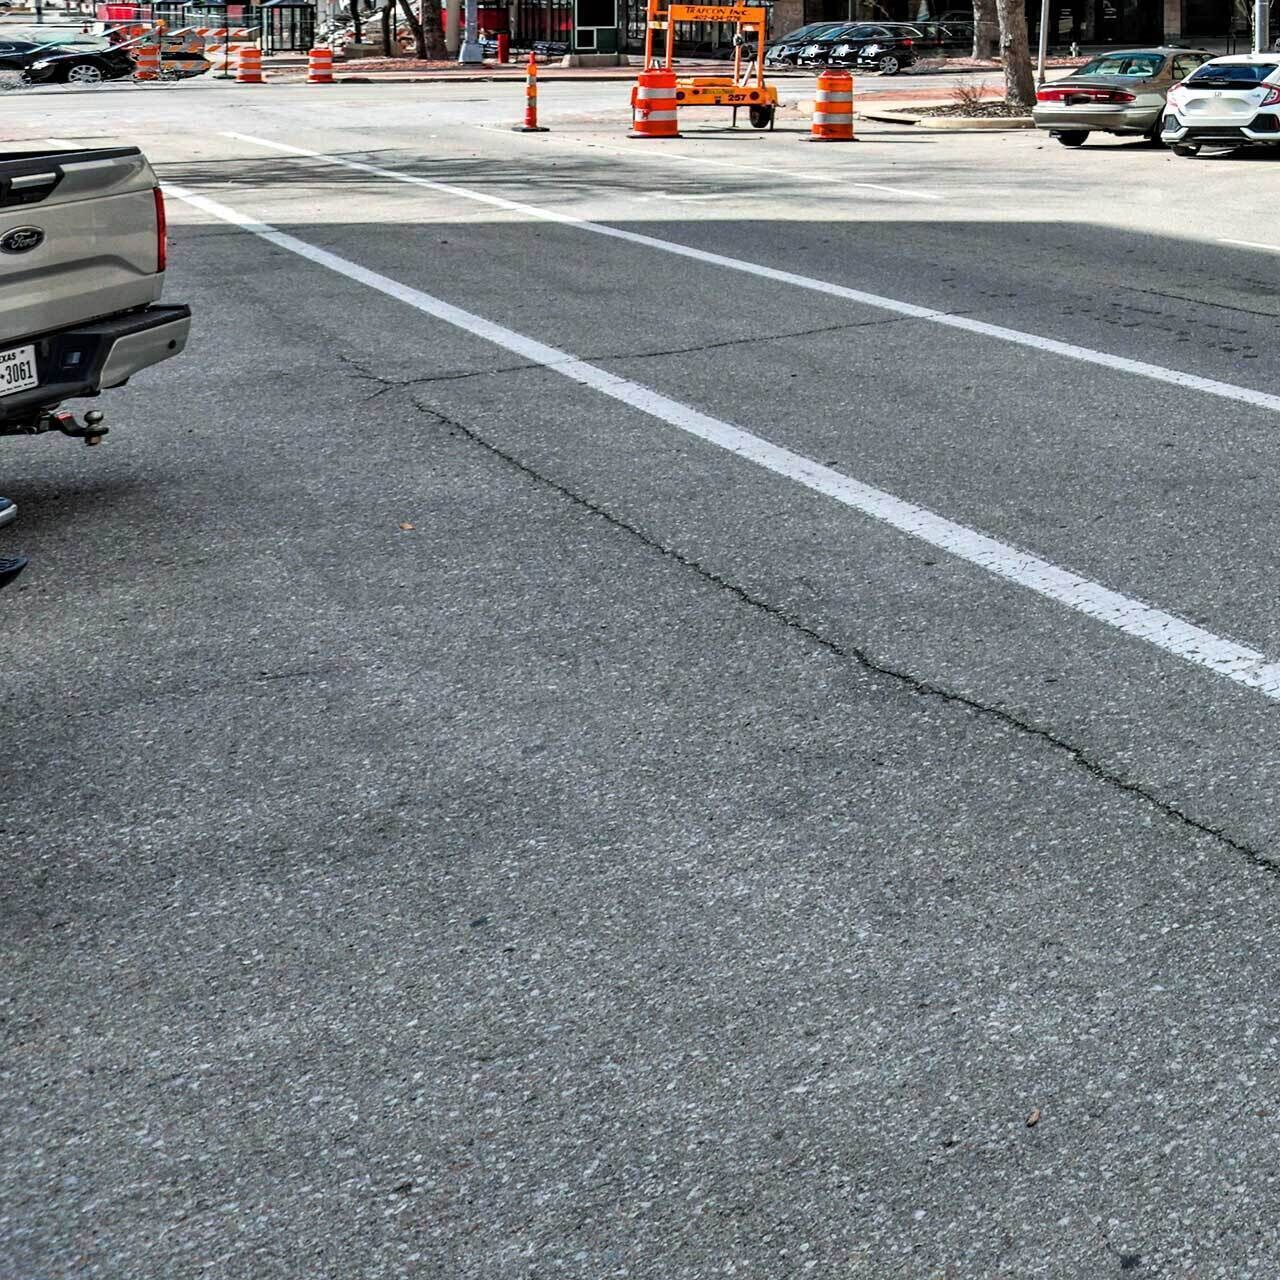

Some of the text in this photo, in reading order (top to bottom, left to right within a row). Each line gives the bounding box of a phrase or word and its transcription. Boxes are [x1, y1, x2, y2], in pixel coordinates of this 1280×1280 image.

[728, 94, 747, 102] 257
[11, 231, 38, 249] Ford
[5, 360, 34, 385] 3061
